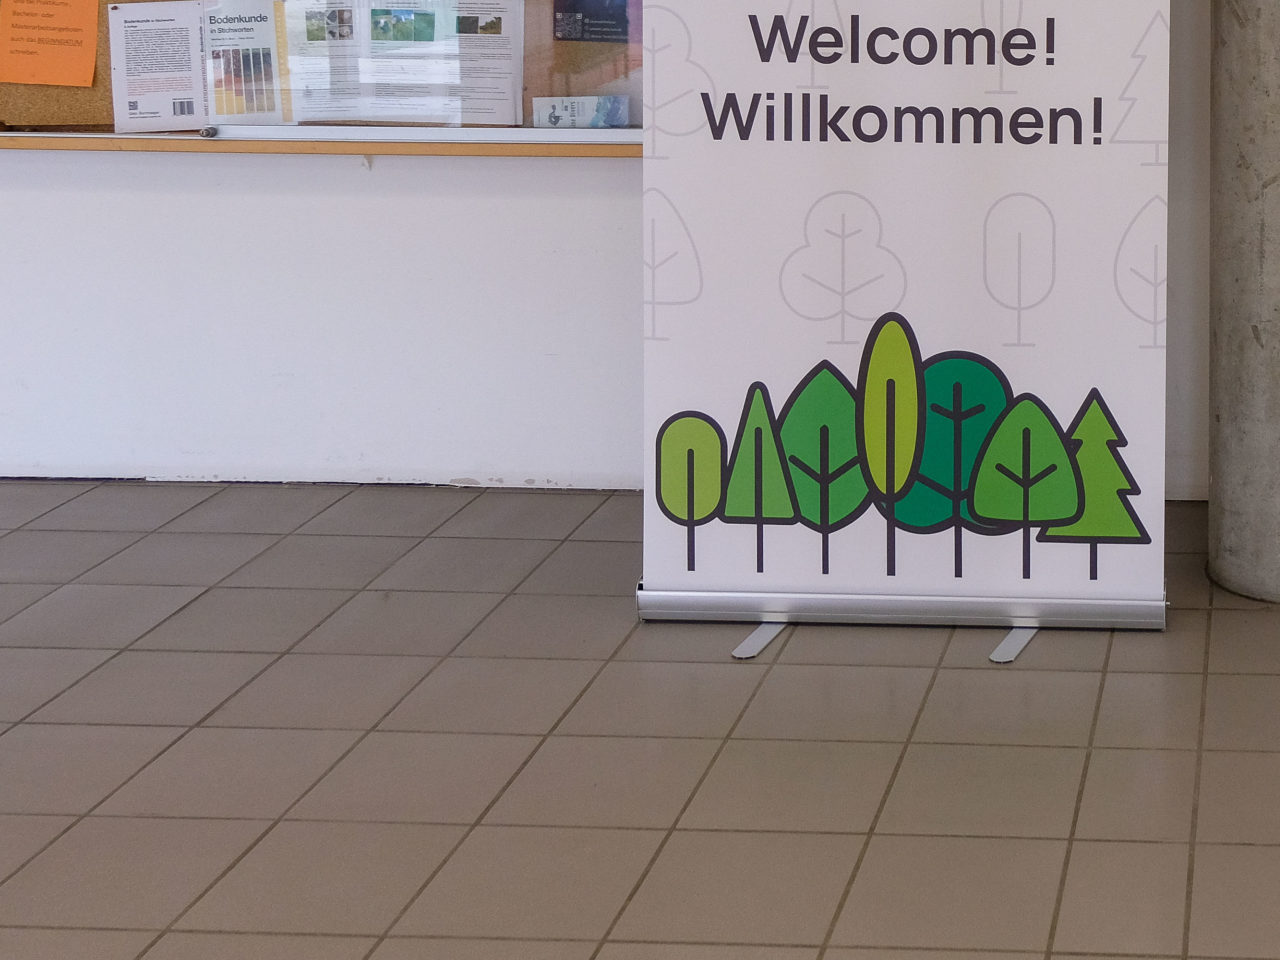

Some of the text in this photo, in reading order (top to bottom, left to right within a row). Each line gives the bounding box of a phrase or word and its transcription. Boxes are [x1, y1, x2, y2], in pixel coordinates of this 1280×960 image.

[210, 14, 268, 24] Bodenkunde
[218, 26, 254, 34] Stichworten
[748, 14, 1056, 66] Welcome!
[701, 92, 1103, 145] Willkommen!
